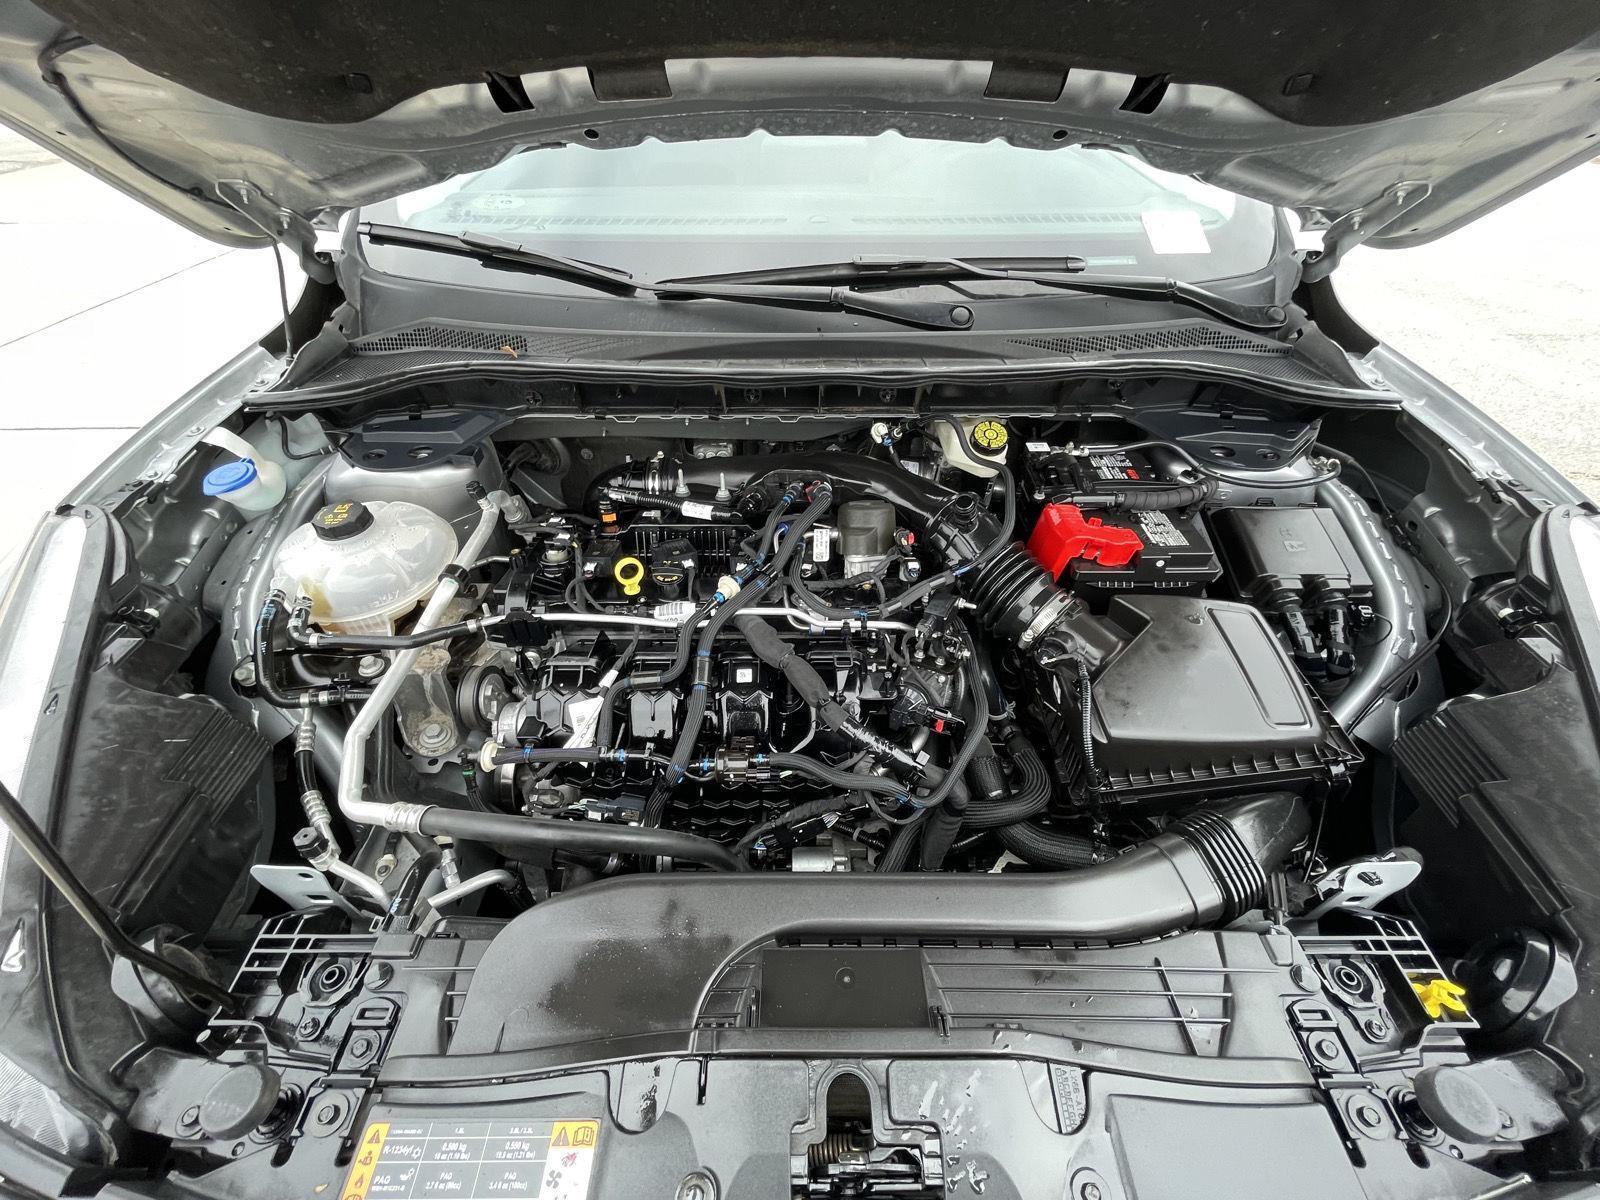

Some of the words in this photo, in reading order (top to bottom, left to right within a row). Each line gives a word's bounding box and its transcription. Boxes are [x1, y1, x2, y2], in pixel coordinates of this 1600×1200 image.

[382, 1144, 414, 1156] R-1234yf
[459, 1142, 468, 1153] kg
[521, 1141, 530, 1152] kg
[373, 1175, 391, 1184] PAG
